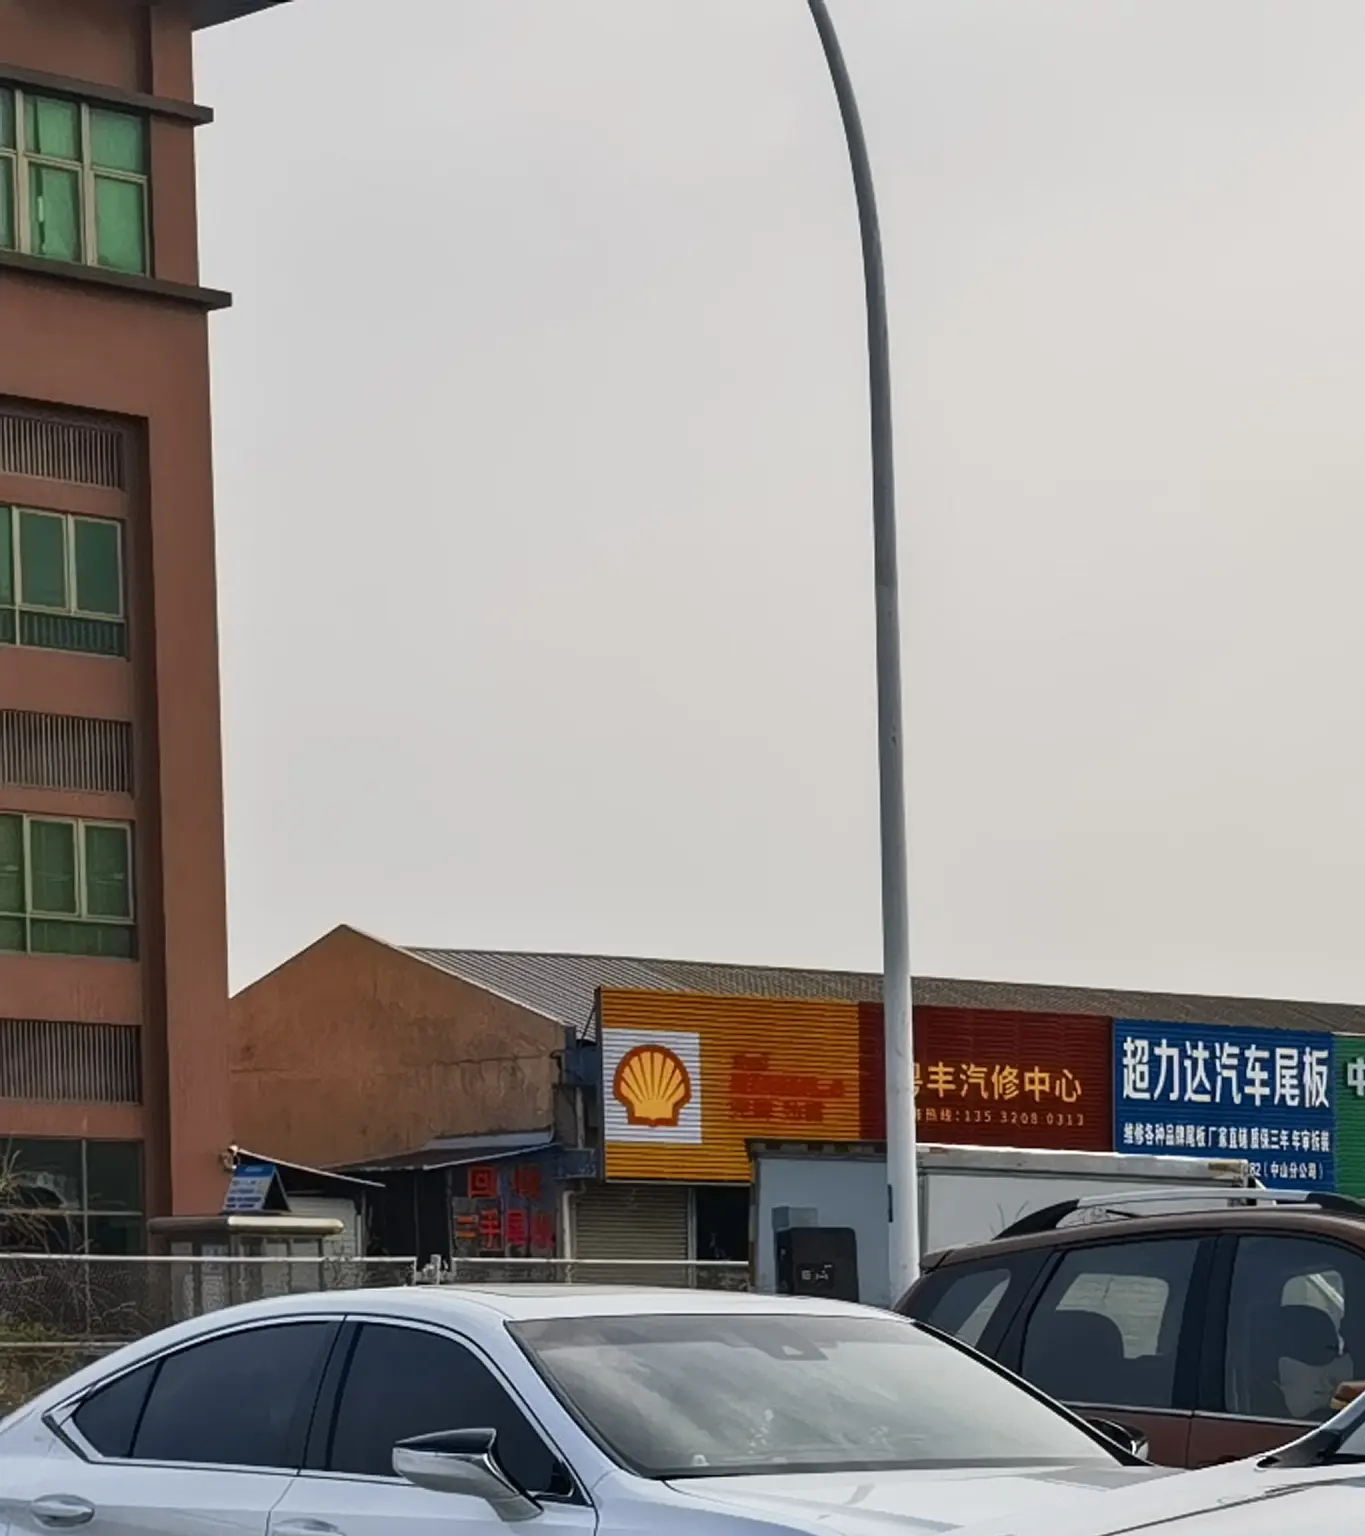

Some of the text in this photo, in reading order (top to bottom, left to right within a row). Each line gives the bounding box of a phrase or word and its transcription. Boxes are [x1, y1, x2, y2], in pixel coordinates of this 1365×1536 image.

[1122, 1036, 1330, 1108] 超力达汽车尾板
